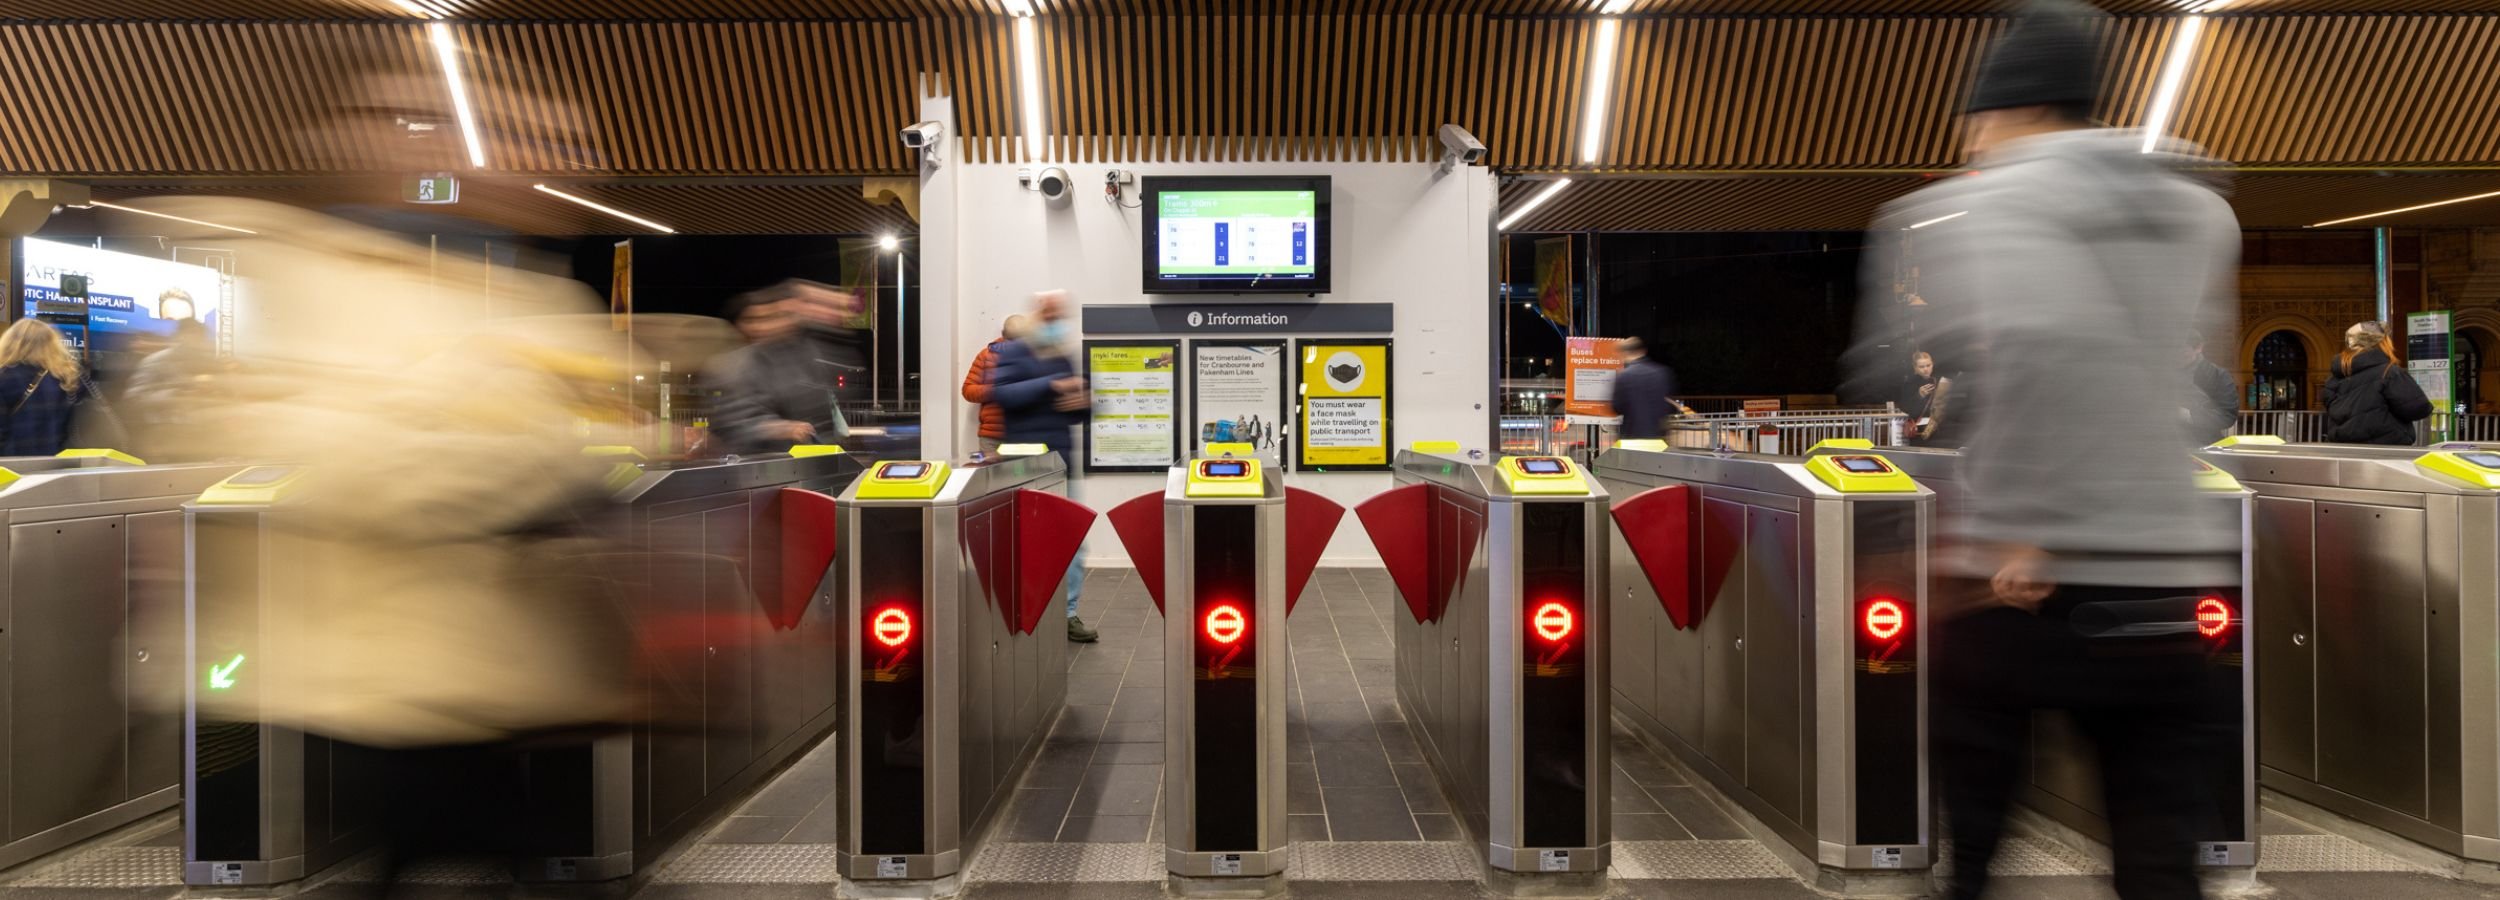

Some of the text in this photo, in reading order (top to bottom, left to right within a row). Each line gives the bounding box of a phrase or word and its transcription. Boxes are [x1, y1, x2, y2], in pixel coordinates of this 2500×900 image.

[1207, 312, 1288, 325] Information
[1093, 351, 1128, 360] myki fares
[1570, 348, 1593, 356] Buses
[1570, 357, 1620, 365] replace trains
[2432, 360, 2448, 368] 127
[1332, 419, 1367, 427] travelling
[1310, 428, 1371, 436] public transport
